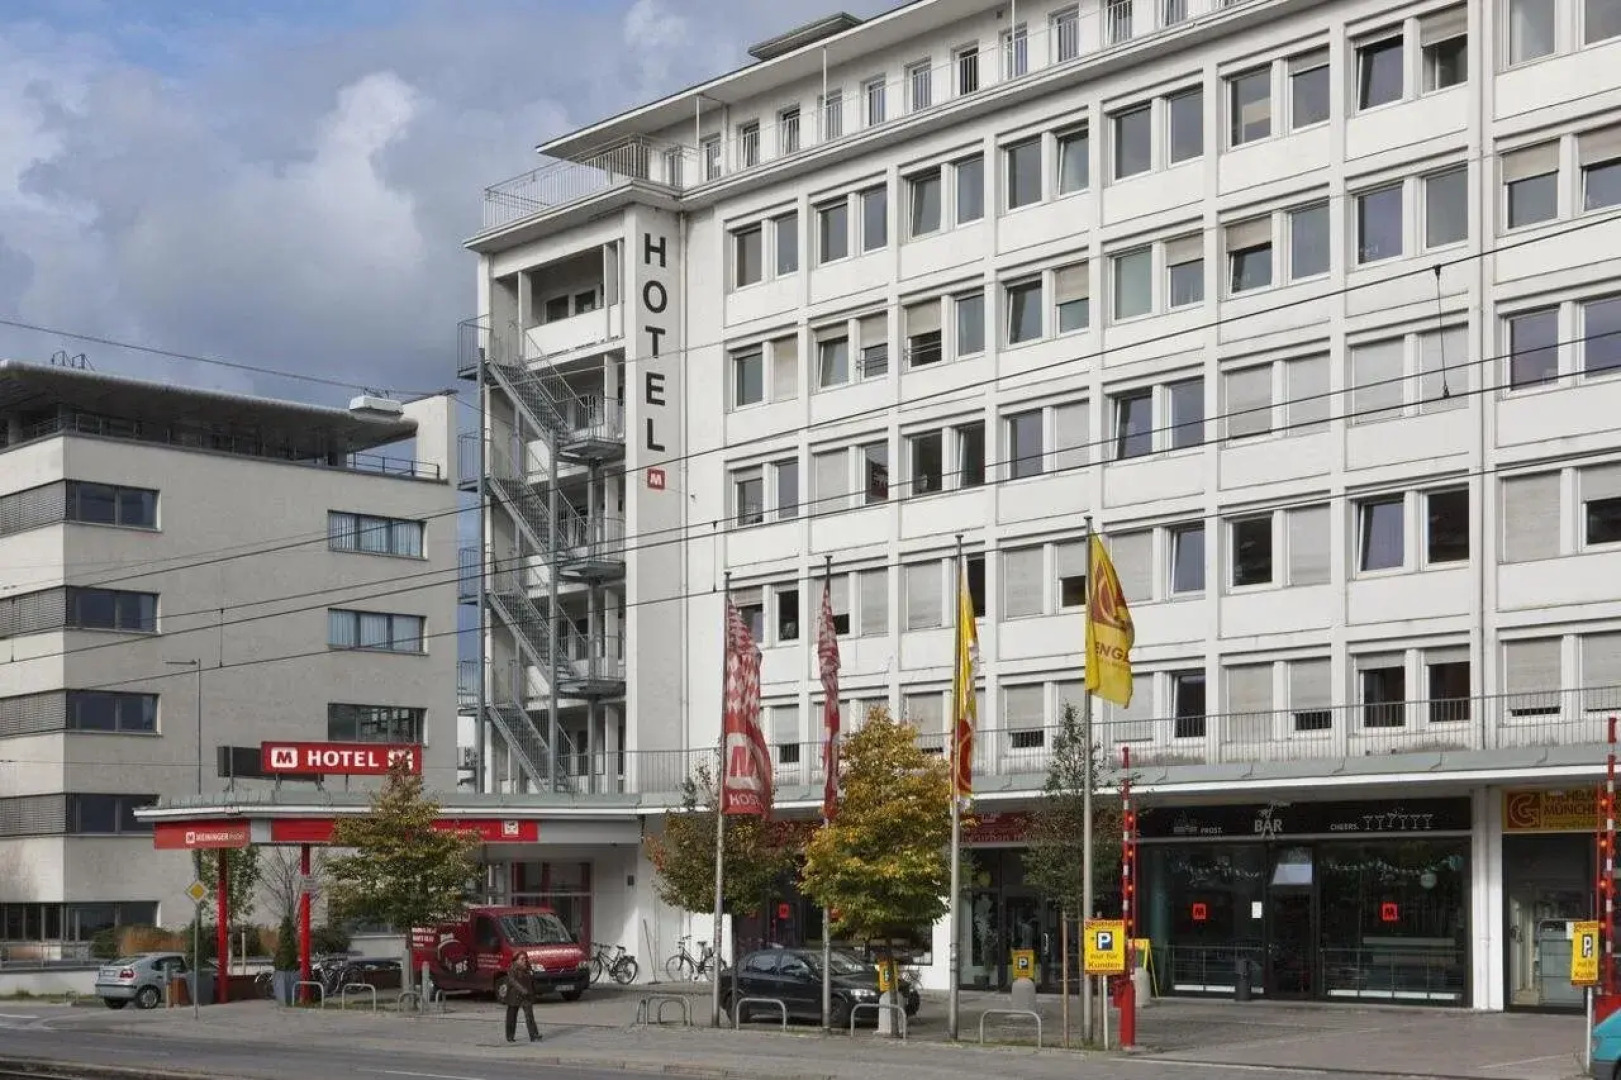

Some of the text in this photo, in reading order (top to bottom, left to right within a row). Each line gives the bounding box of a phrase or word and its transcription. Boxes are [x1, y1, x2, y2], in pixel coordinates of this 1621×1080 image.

[643, 233, 668, 451] HOTEL
[307, 750, 379, 767] HOTEL
[1254, 819, 1283, 839] BAR
[1097, 932, 1111, 949] P
